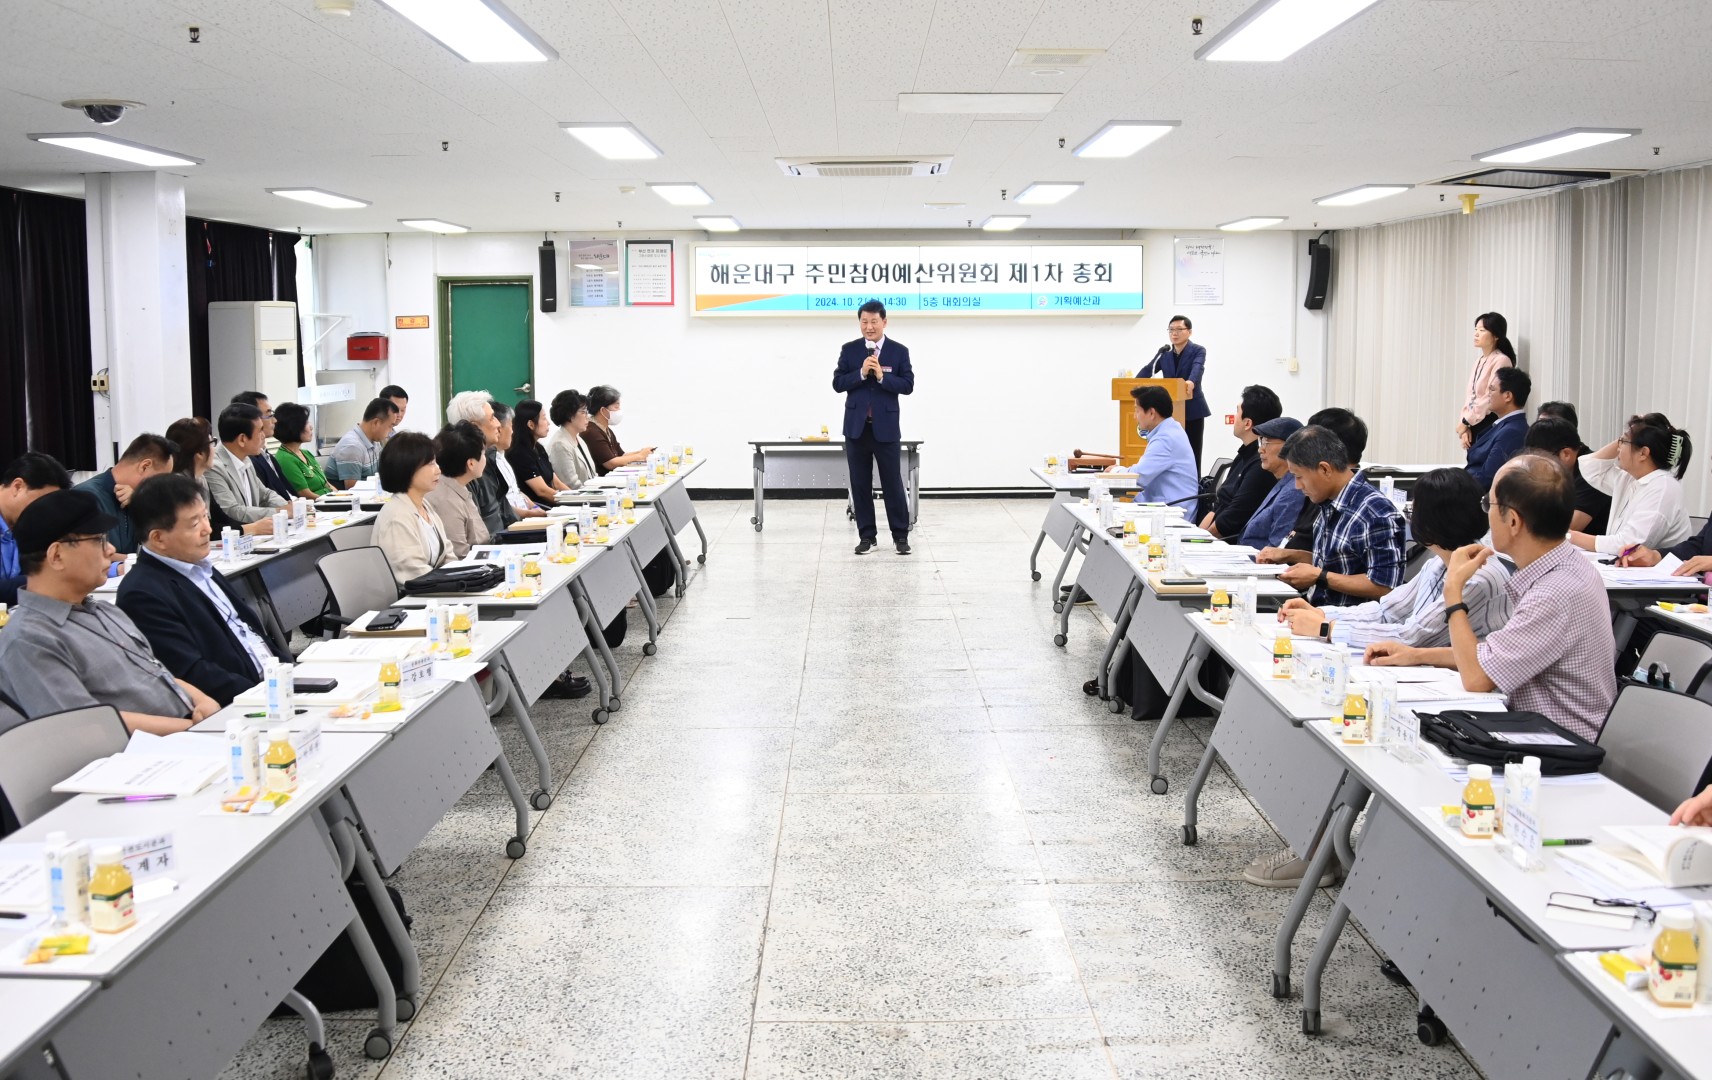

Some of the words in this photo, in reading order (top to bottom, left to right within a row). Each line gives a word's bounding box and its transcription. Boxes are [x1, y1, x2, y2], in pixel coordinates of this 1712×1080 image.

[710, 263, 795, 285] 해운대구
[805, 262, 999, 284] 주민참여예산위원회
[1008, 262, 1064, 284] 제1차
[1072, 262, 1113, 284] 총회
[815, 297, 839, 307] 2024.
[843, 297, 855, 306] 10.
[884, 296, 907, 306] 14:30
[923, 296, 938, 307] 5층
[942, 296, 981, 307] 대회의실
[1054, 295, 1101, 306] 기획예산과
